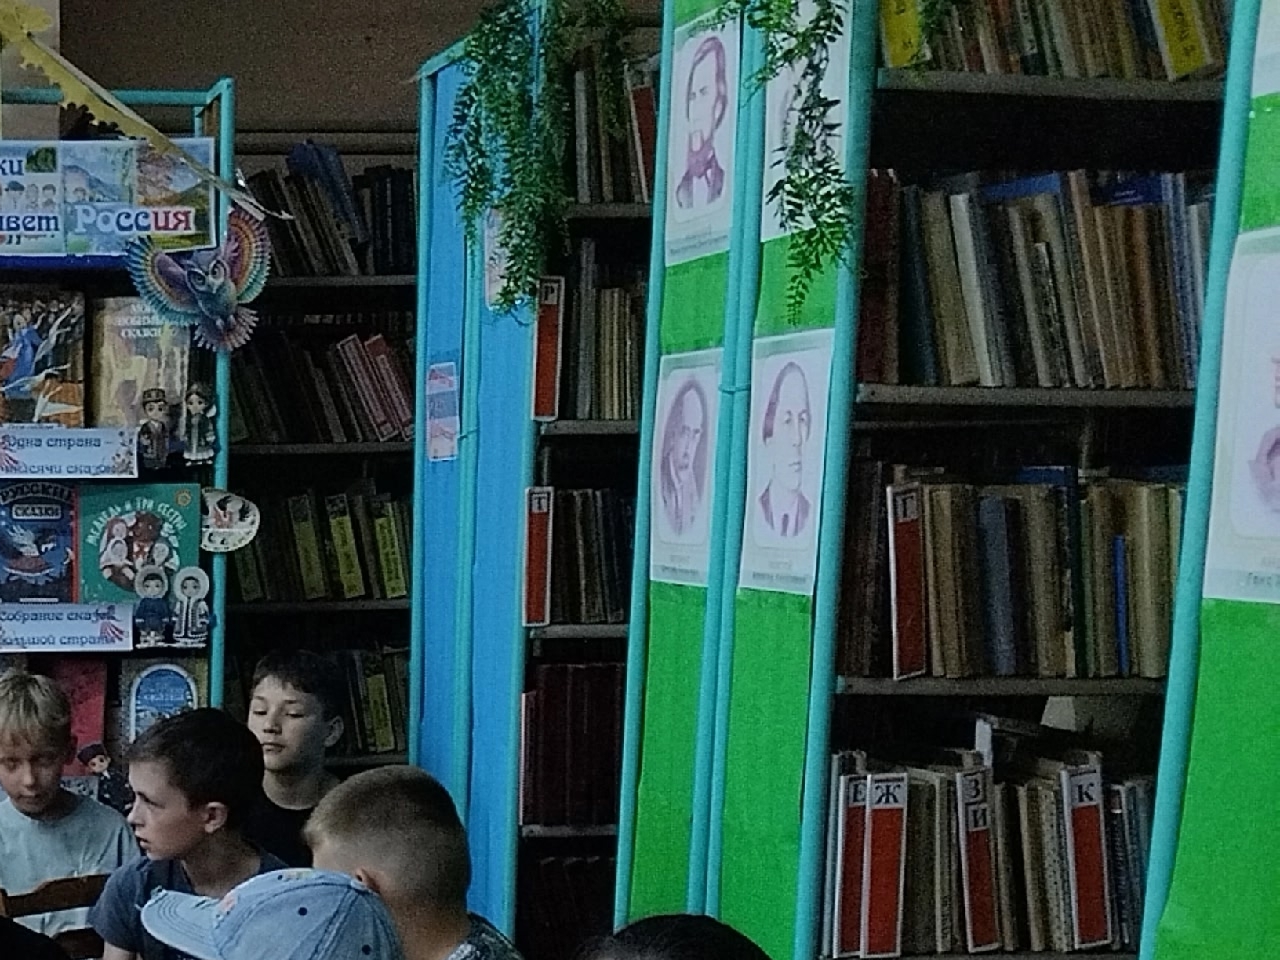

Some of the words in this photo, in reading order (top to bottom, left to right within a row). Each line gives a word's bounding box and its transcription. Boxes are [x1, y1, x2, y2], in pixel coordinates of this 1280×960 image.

[73, 204, 196, 235] Россия
[543, 285, 556, 301] Р
[47, 437, 101, 450] страна
[533, 496, 547, 510] Т
[874, 784, 901, 804] Ж
[967, 778, 981, 799] З
[1077, 784, 1096, 804] К
[972, 808, 988, 828] И
